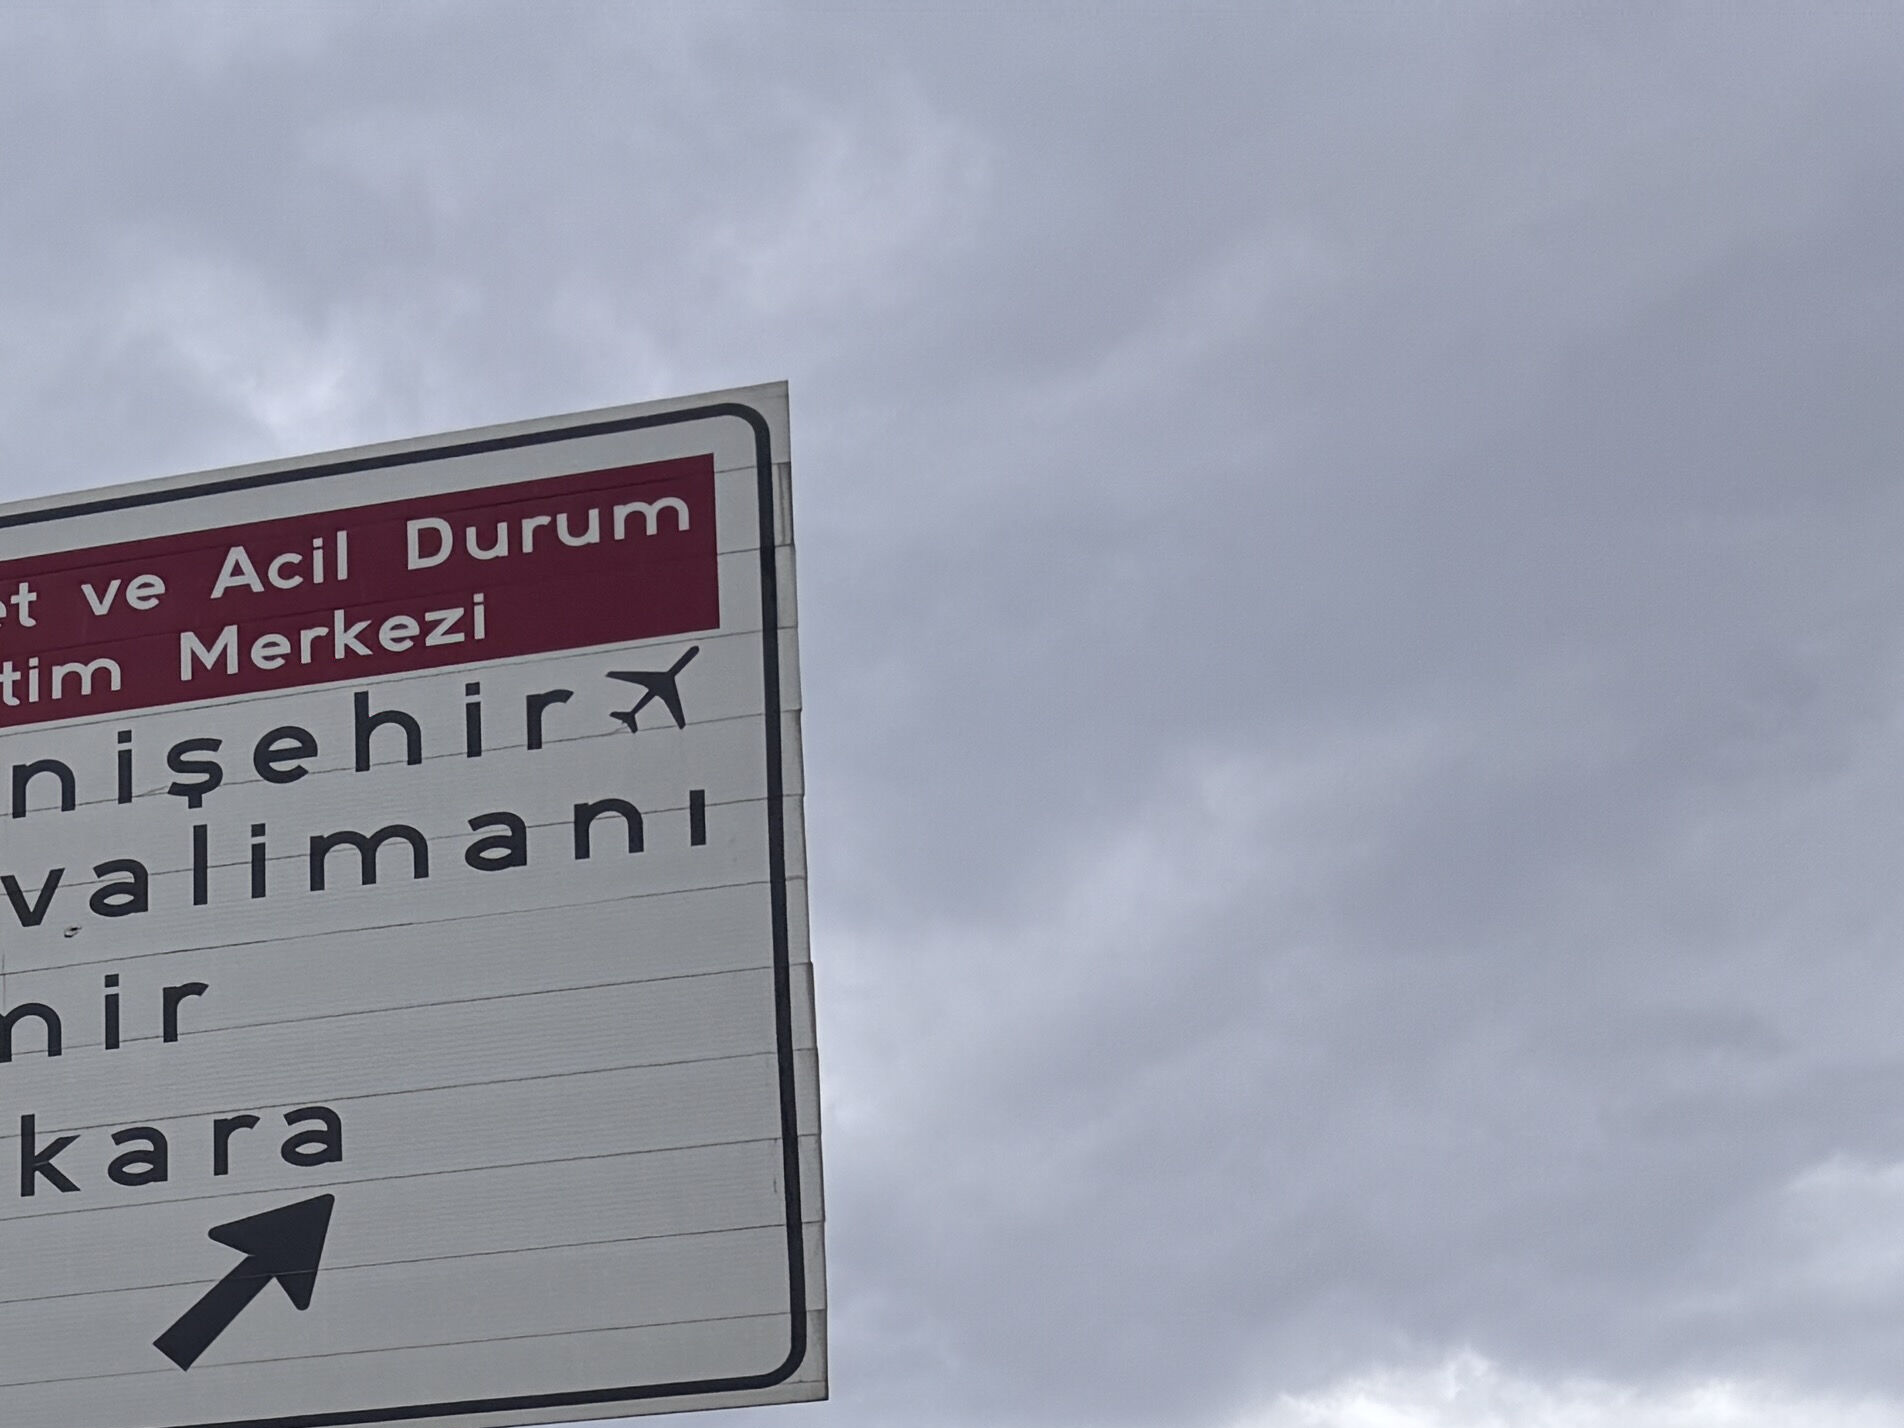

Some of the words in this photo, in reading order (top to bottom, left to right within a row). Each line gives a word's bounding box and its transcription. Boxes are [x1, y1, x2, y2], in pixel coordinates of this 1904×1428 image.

[80, 572, 166, 617] ve
[209, 530, 350, 600] Acil
[406, 495, 690, 572] Durum
[179, 593, 486, 681] Merkezi
